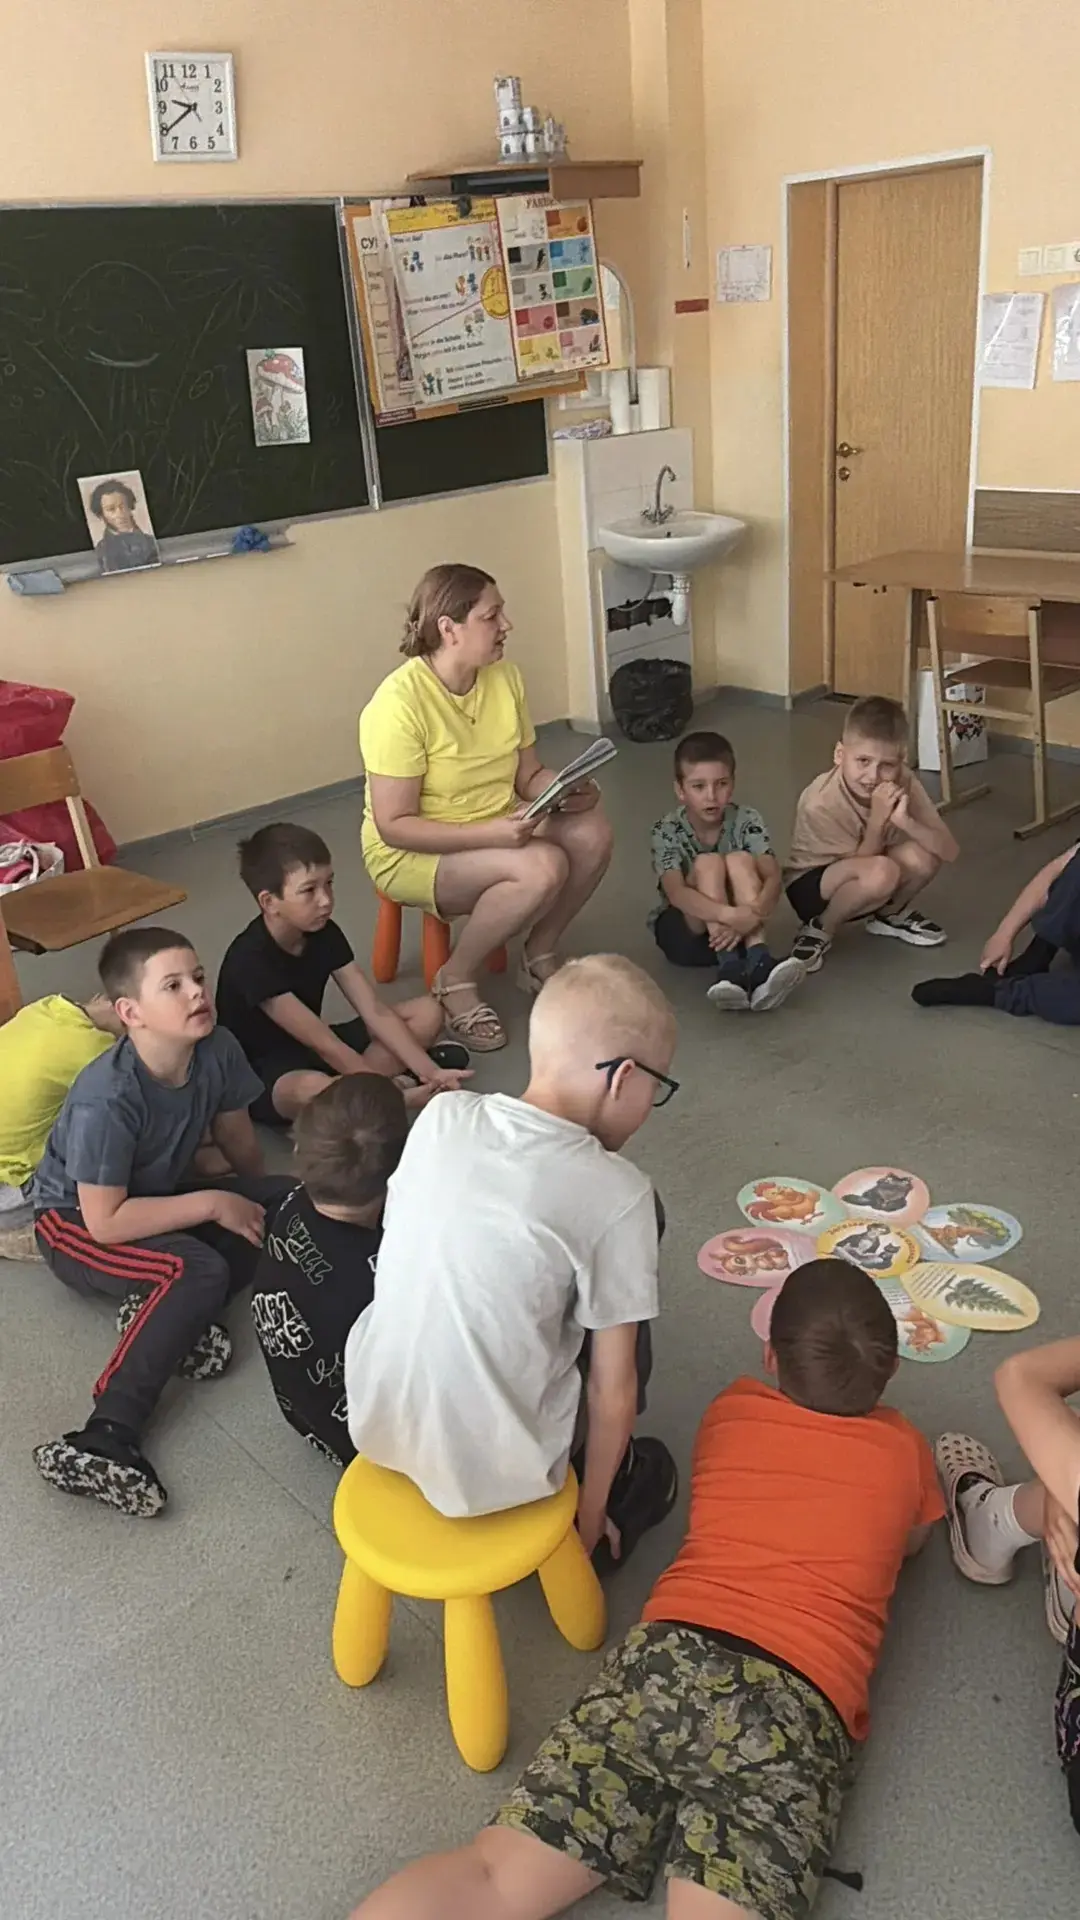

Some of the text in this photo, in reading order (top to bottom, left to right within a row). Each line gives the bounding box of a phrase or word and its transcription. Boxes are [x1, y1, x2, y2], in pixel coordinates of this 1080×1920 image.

[162, 63, 212, 79] 11 12 1
[214, 79, 222, 93] 2
[158, 100, 167, 114] 9
[215, 101, 223, 114] 3
[160, 122, 169, 137] 8
[216, 122, 225, 136] 4
[171, 136, 216, 150] 7 6 5
